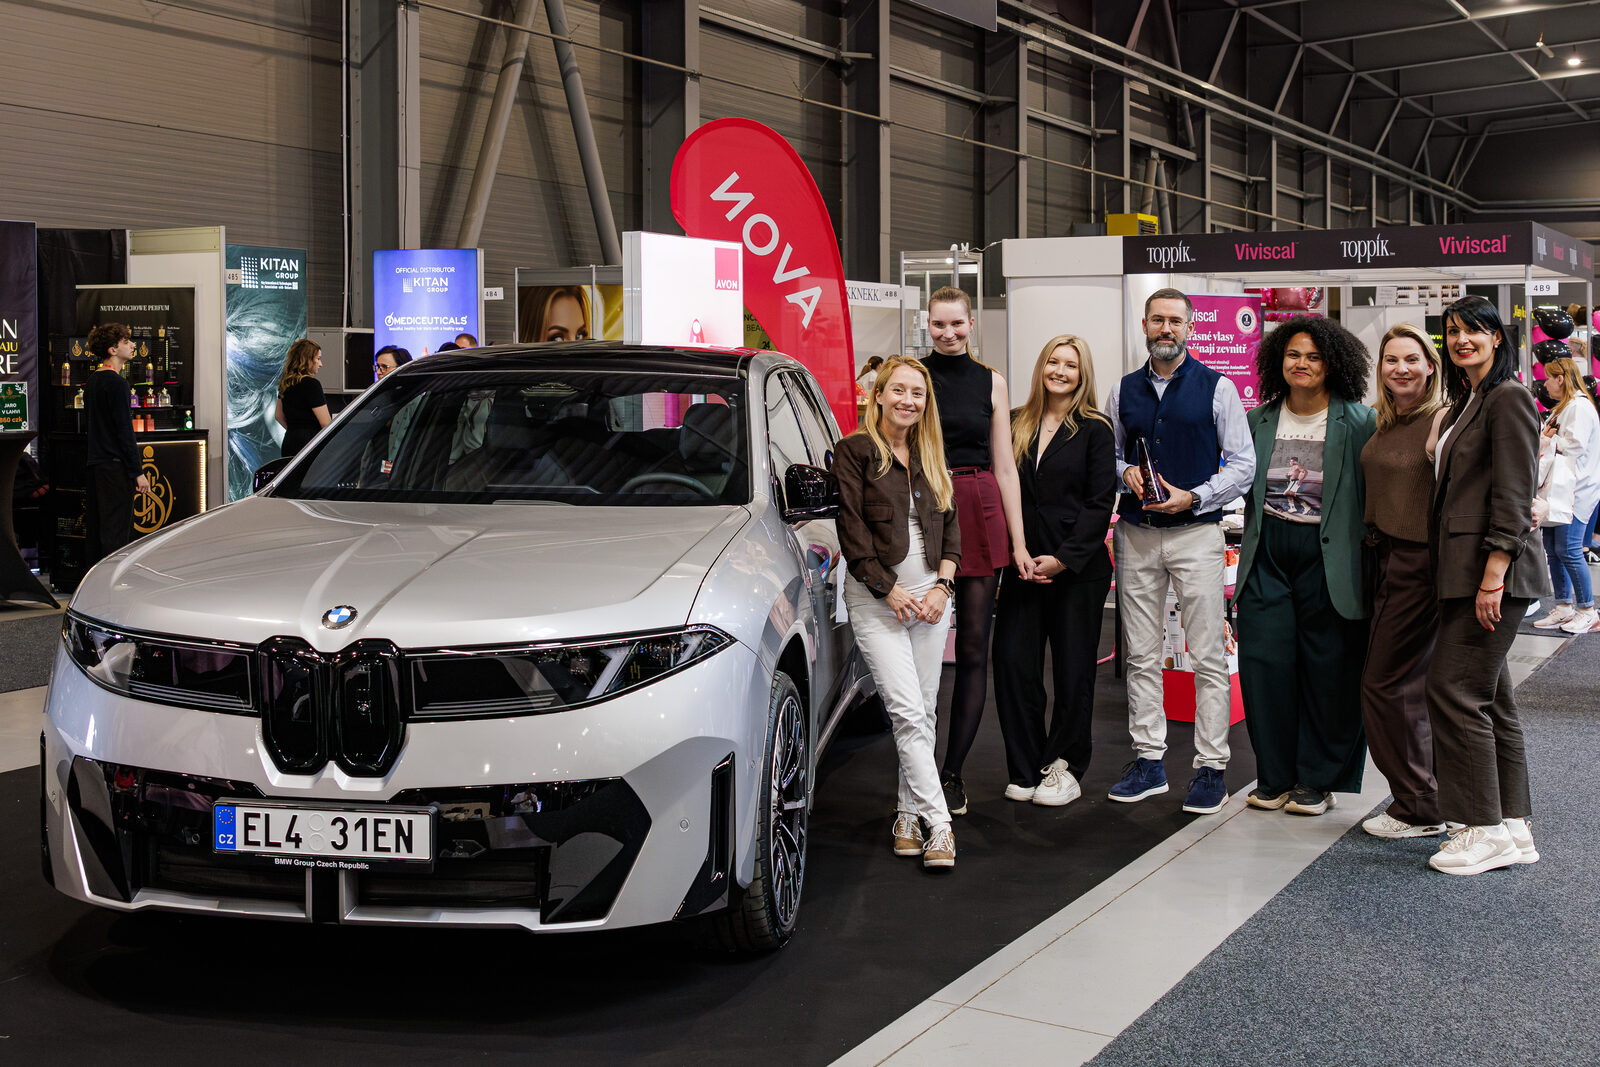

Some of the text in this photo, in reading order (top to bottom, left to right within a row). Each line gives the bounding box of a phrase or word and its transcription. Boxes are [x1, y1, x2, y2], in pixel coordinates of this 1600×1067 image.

[260, 258, 298, 272] KITAN
[414, 277, 448, 287] KITAN
[716, 279, 738, 289] AVON
[0, 319, 17, 339] N
[1187, 331, 1234, 343] rásné vlasy
[1216, 344, 1247, 354] zevnitř
[218, 834, 233, 844] CZ
[330, 816, 413, 853] 31EN
[294, 859, 315, 867] Group
[339, 861, 369, 870] Republic
